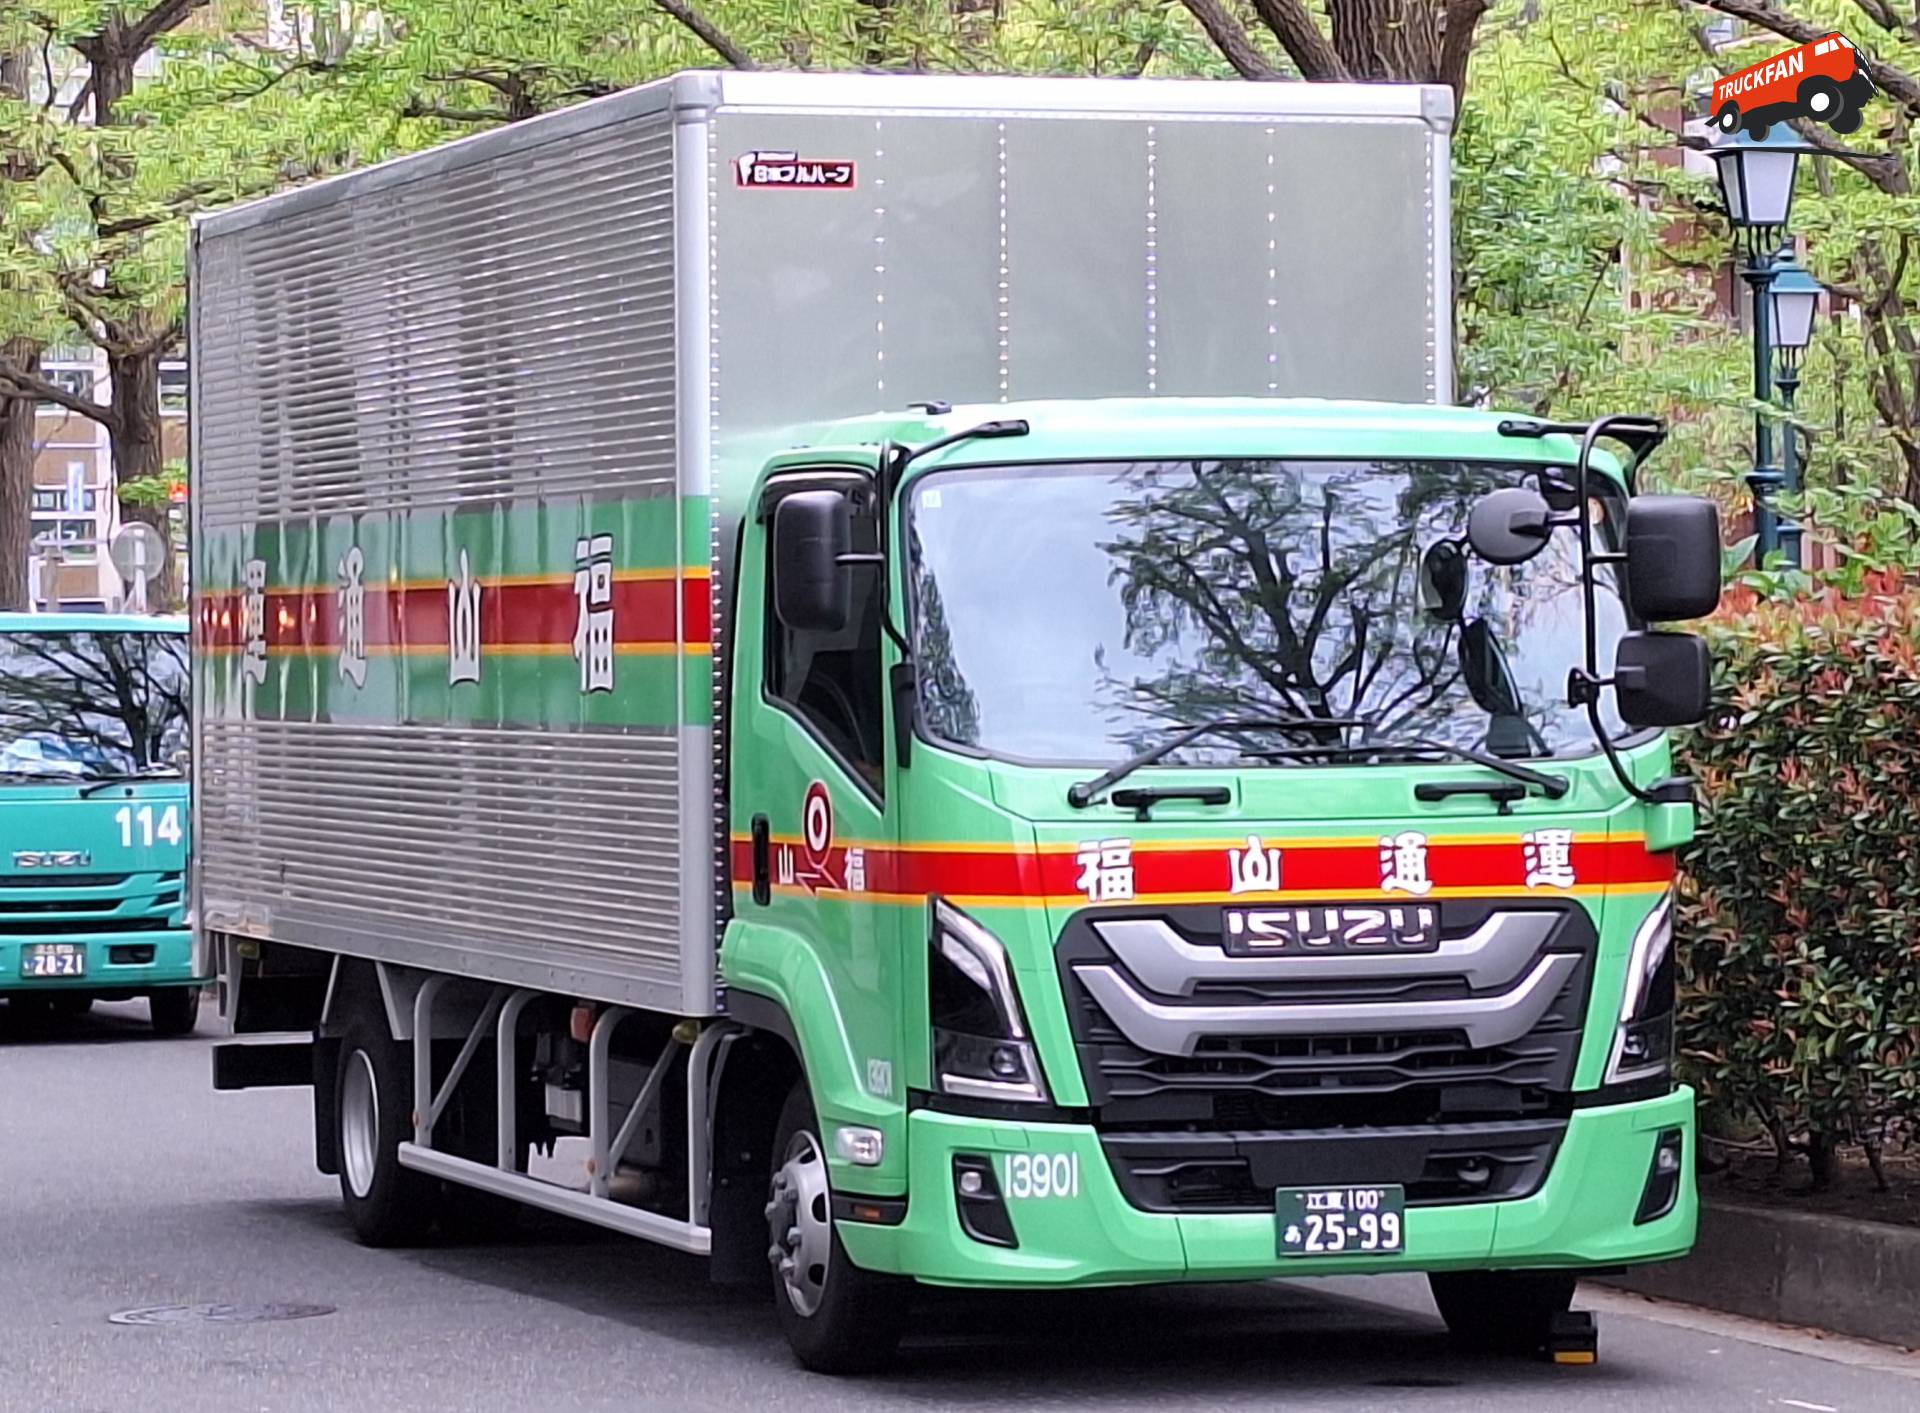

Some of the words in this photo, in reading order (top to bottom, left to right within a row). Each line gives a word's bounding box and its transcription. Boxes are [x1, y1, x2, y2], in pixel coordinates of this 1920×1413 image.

[115, 805, 182, 847] 114
[1076, 828, 1575, 901] 福山通運
[1227, 907, 1434, 950] ISUZU
[1004, 1151, 1078, 1198] 13901
[1348, 1189, 1378, 1211] 100
[1305, 1212, 1400, 1251] 25-99
